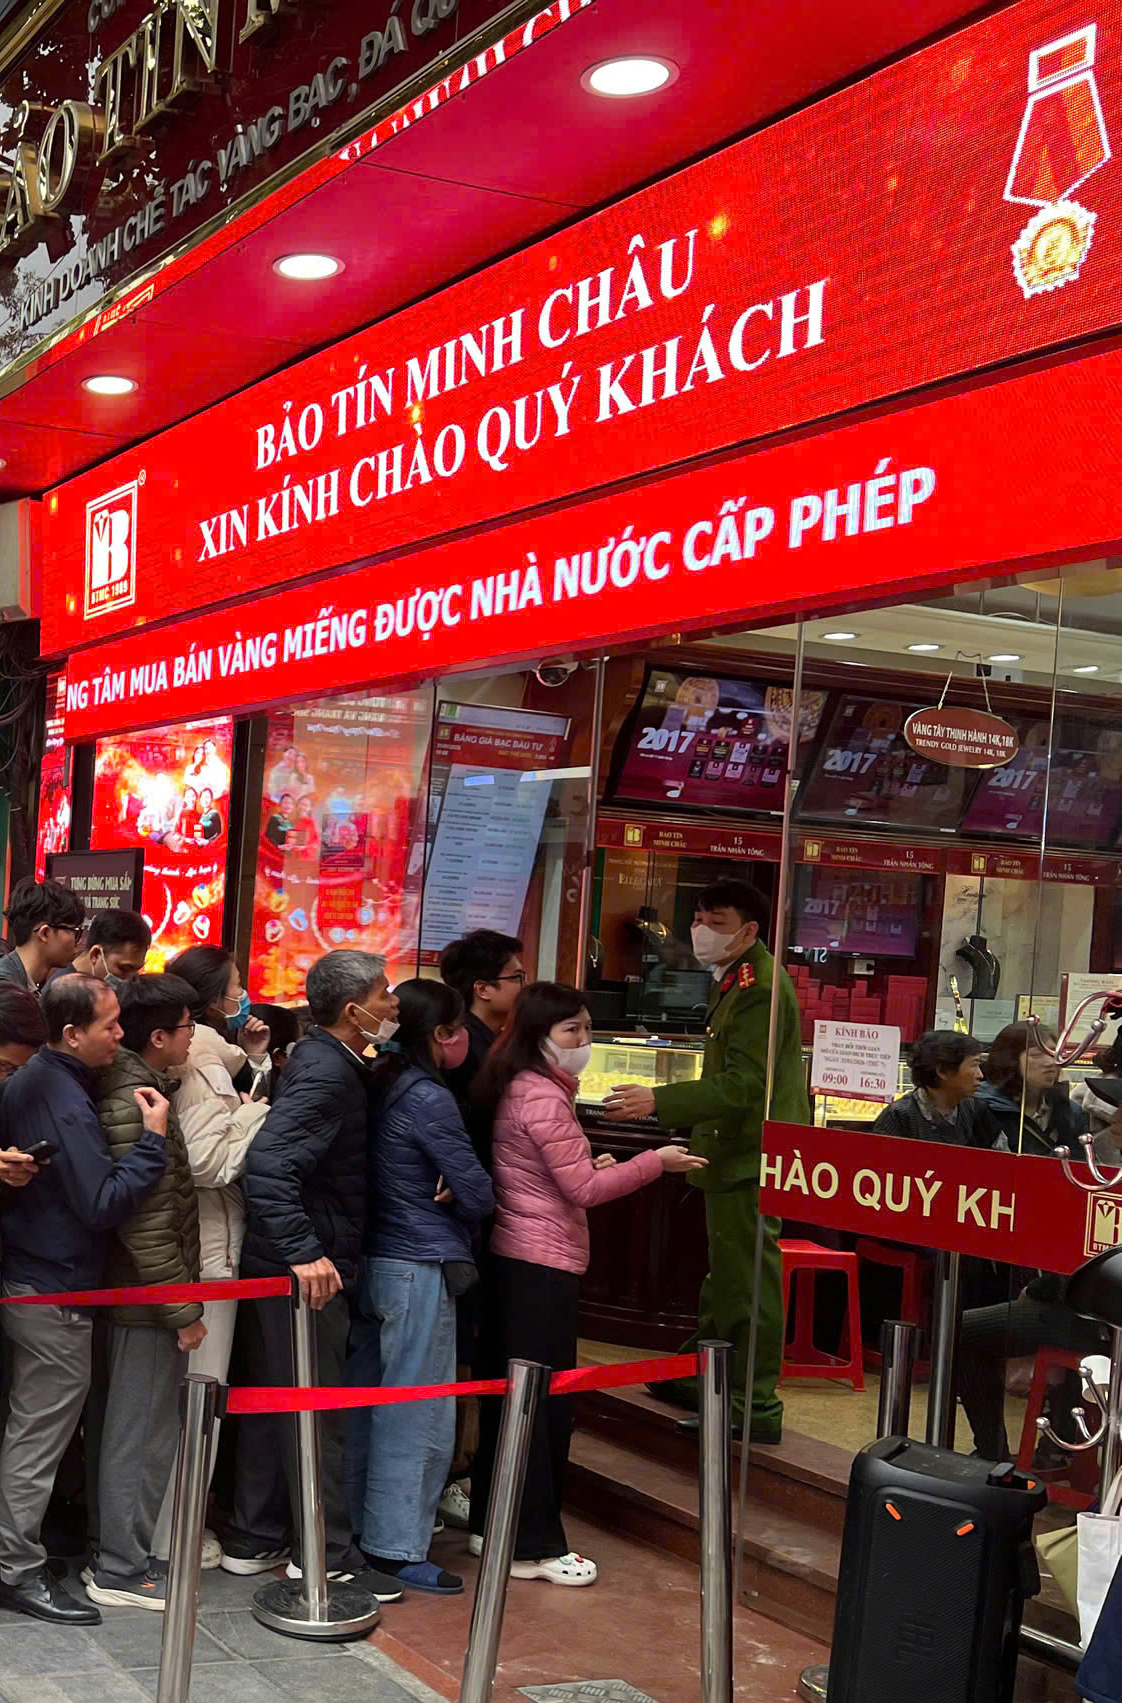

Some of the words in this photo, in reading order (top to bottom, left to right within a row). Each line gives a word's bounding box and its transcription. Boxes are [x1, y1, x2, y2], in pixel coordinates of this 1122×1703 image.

[19, 278, 59, 331] KINH
[59, 226, 123, 302] DOANH
[170, 158, 213, 217] TÁC
[217, 105, 284, 183] VÀNG
[256, 400, 324, 470] BẢO
[331, 364, 395, 437] TÍN
[404, 308, 525, 409] MINH
[539, 229, 699, 348] CHÂU
[197, 505, 249, 562] XIN
[256, 475, 341, 542] KÍNH
[349, 422, 466, 507] CHÀO
[477, 361, 584, 472] QUÝ
[595, 277, 831, 423] KHÁCH
[92, 670, 126, 706] TÂM
[129, 660, 168, 698] MUA
[173, 642, 213, 688] BÁN
[219, 630, 278, 678] VÀNG
[283, 605, 367, 663] MIẾNG
[374, 579, 462, 641] ĐƯỢC
[470, 552, 544, 621] NHÀ
[553, 524, 673, 603] NƯỚC
[682, 496, 775, 572] CẤP
[789, 457, 937, 550] PHÉP
[637, 727, 697, 754] 2017
[912, 721, 932, 736] VÀNG
[933, 723, 945, 738] TÂY
[916, 738, 939, 748] TRENDY
[940, 741, 957, 751] GOLD
[957, 744, 982, 754] JEWELRY
[823, 749, 878, 774] 2017
[987, 767, 1039, 790] 2017
[733, 836, 743, 845] 15
[803, 897, 840, 915] 2017
[835, 1026, 858, 1038] KÍNH
[859, 1028, 879, 1040] BÁO
[822, 1073, 848, 1085] 09:00
[860, 1077, 886, 1090] 16:30
[759, 1149, 839, 1199] HÀO
[852, 1170, 943, 1217] QUÝ
[956, 1185, 1016, 1233] KH
